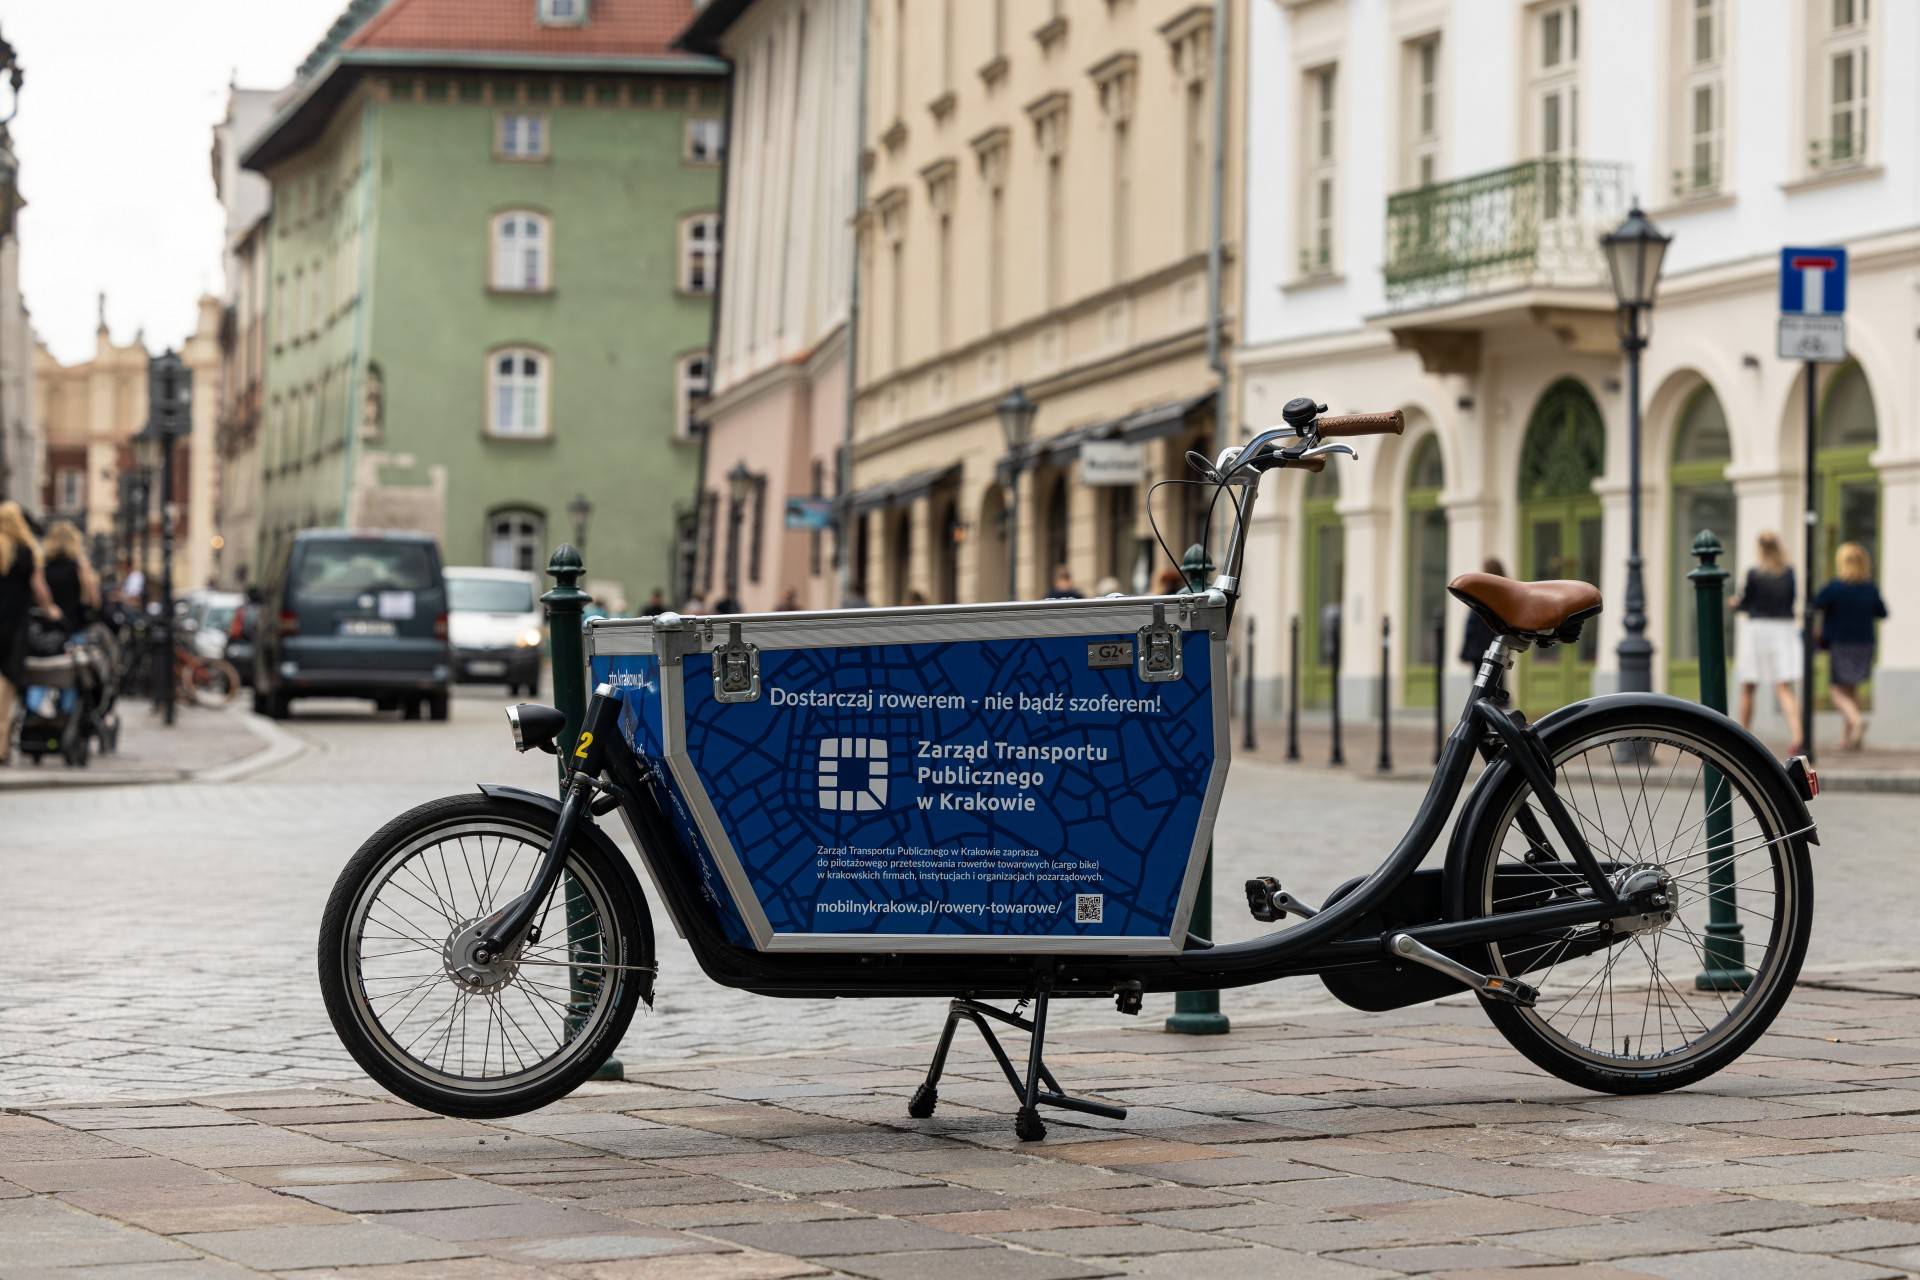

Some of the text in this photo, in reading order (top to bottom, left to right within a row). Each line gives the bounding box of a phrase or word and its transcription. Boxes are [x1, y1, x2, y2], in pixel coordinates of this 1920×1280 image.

[1099, 646, 1119, 658] G2
[770, 687, 873, 712] Dostarczaj
[879, 694, 965, 710] rowerem
[984, 692, 1014, 710] nie
[1019, 692, 1064, 715] bądź
[1069, 693, 1161, 713] szoferem!
[575, 731, 593, 759] 2
[917, 740, 1107, 764] Zarząd Transportu
[917, 767, 1044, 790] Publicznego
[917, 794, 1036, 812] w Krakowie
[817, 845, 847, 857] Zarząd
[849, 846, 895, 857] Transportu
[897, 846, 949, 858] Publicznego
[960, 847, 1001, 857] Krakowie
[1002, 849, 1039, 858] zaprasza
[817, 858, 1100, 870] do pilotażowego przetestowania rowerów towarowych (cargo bike)
[817, 872, 825, 880] w
[827, 871, 881, 880] krakowskich
[882, 871, 917, 881] firmach,
[919, 871, 971, 882] instytucjach
[977, 871, 1035, 882] organizacjach
[1036, 872, 1104, 882] pozarządowych.
[816, 898, 1063, 916] mobilnykrakow.pl/rowery-towarowe/
